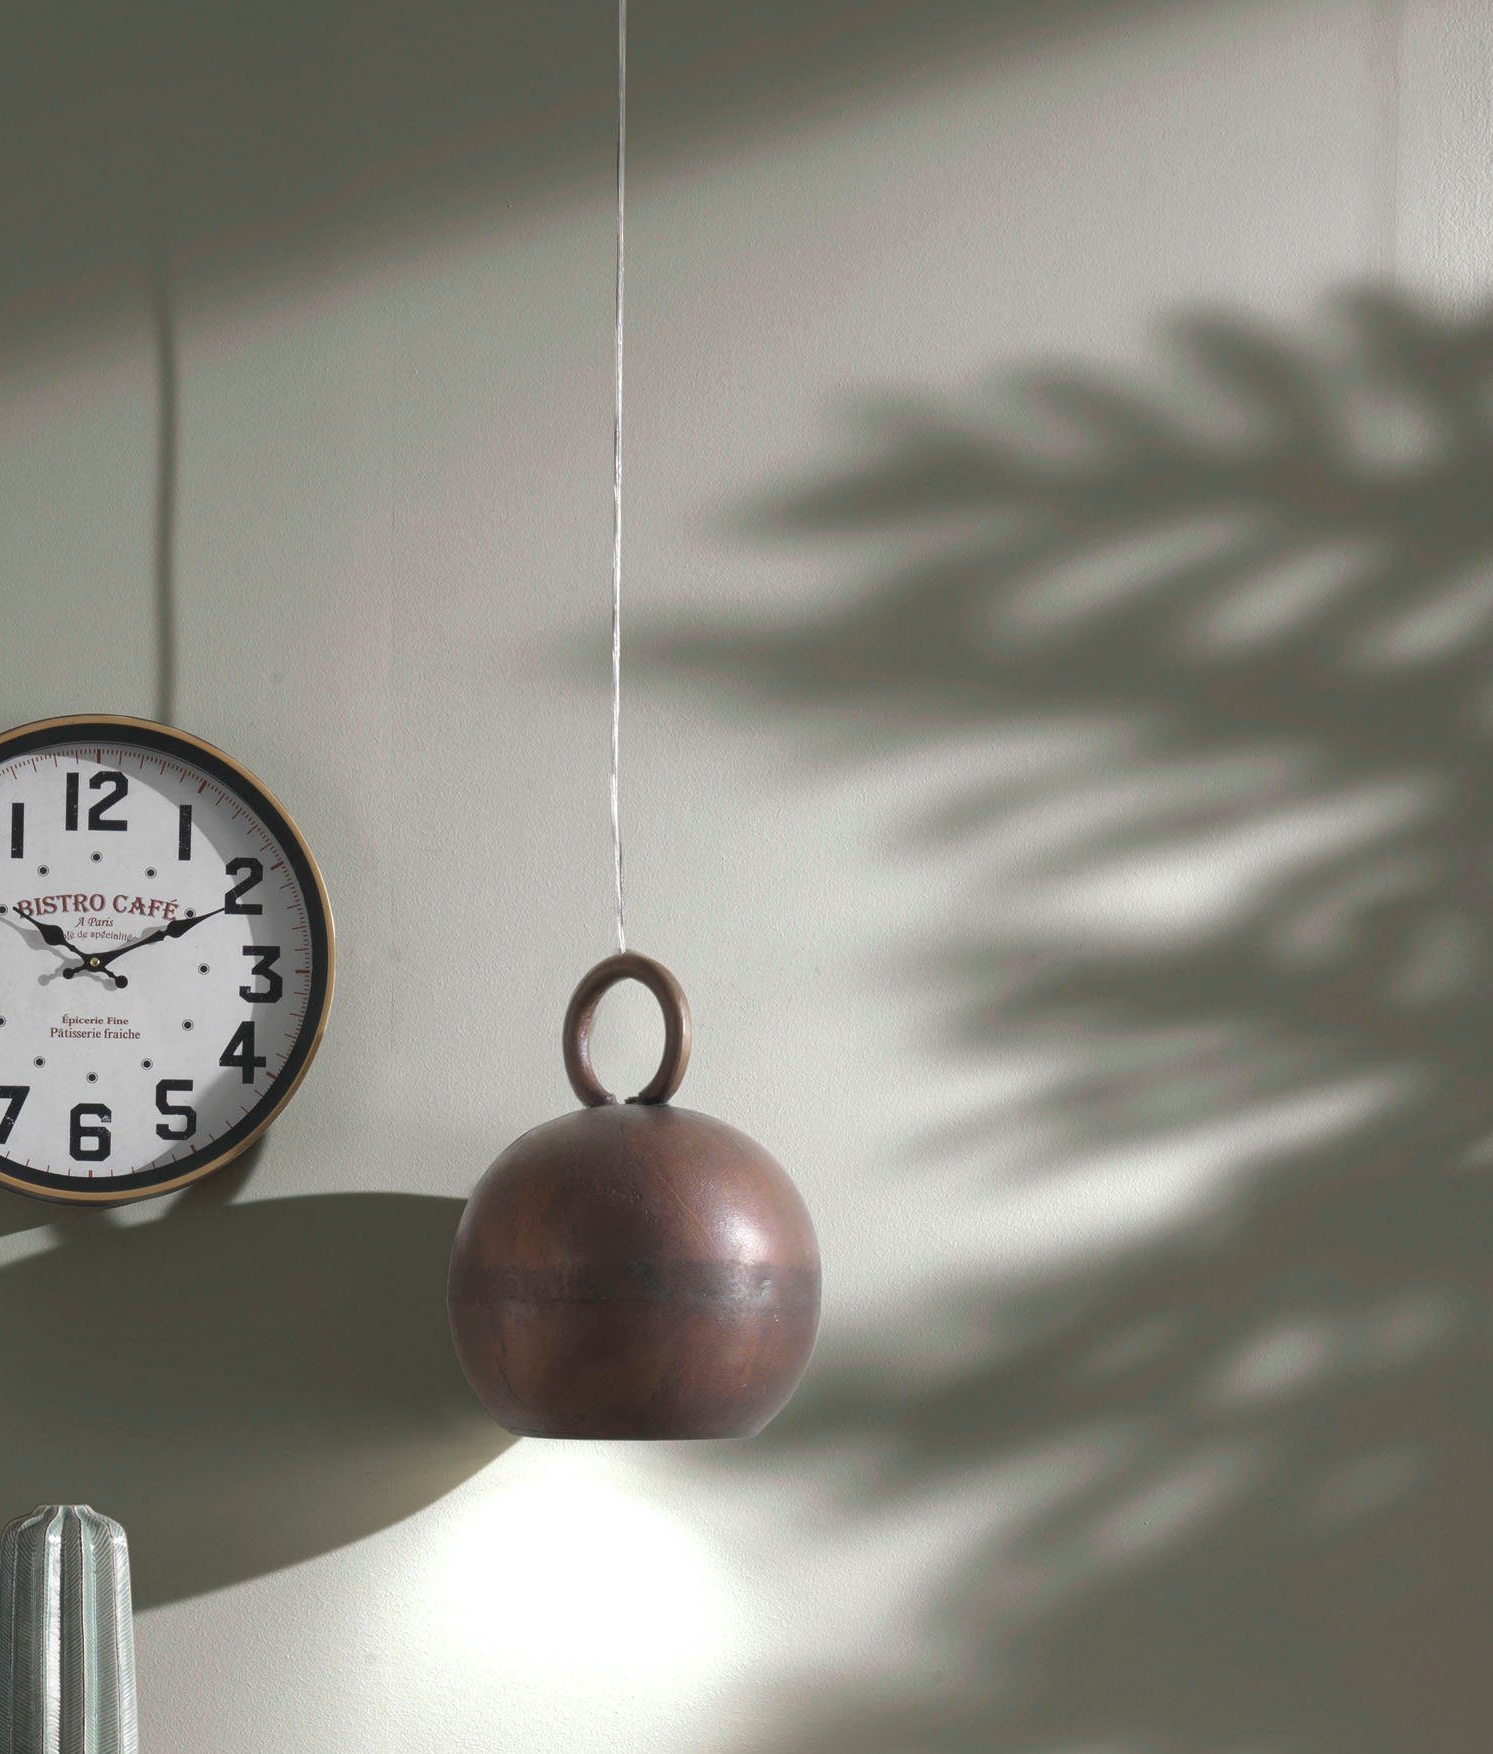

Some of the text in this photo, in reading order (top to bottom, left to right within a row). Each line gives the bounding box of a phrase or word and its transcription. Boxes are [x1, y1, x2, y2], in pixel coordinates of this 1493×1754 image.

[65, 771, 128, 831] 12
[178, 804, 192, 861] 1
[17, 893, 180, 921] BISTRO CAFÉ
[224, 857, 264, 915] 2
[87, 917, 114, 928] Paris
[239, 945, 283, 1003] 3
[50, 1027, 141, 1039] Pâtisserie fraiche
[62, 1013, 129, 1026] Épicerie Fine
[219, 1021, 267, 1084] 4
[69, 1103, 112, 1161] 6
[155, 1079, 197, 1140] 5
